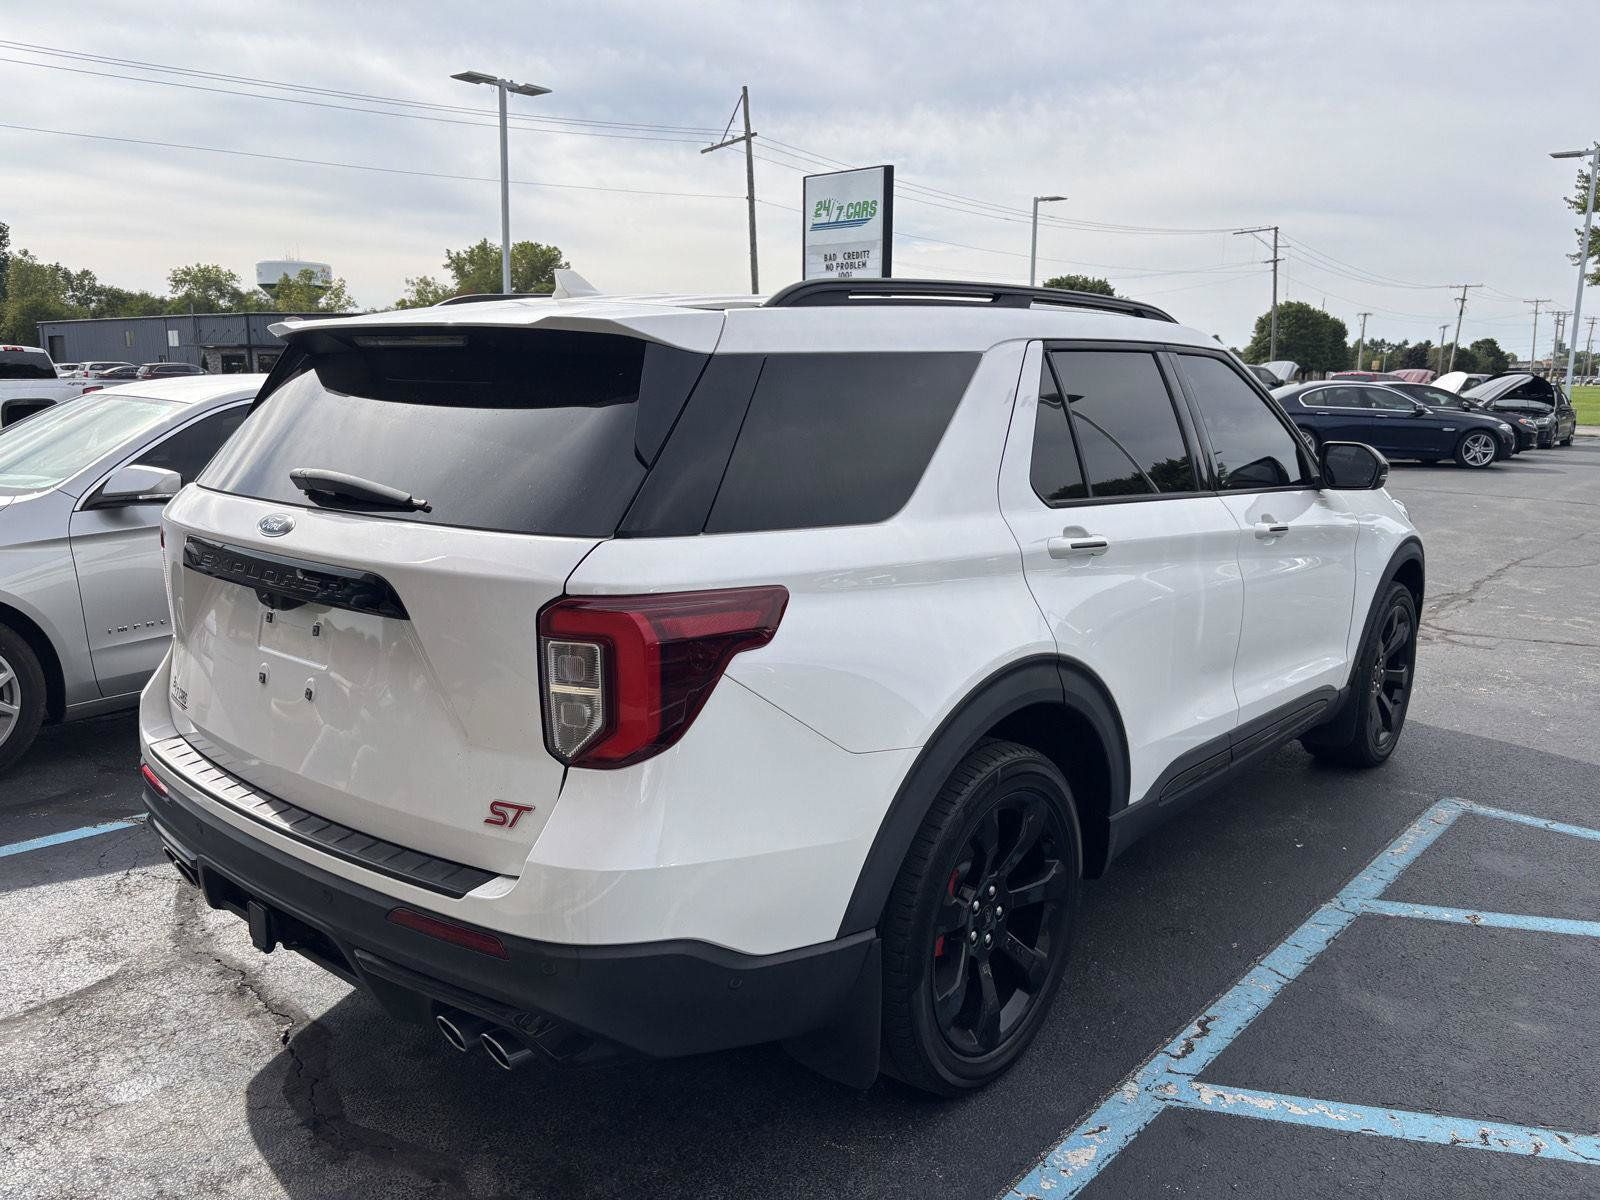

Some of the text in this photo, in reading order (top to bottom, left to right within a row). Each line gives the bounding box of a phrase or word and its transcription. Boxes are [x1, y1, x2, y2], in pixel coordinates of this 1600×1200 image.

[846, 200, 877, 219] CARS
[843, 250, 869, 260] CREDIT?
[836, 261, 866, 271] PROBLEM
[200, 553, 345, 598] EXPLORER
[484, 801, 535, 828] ST
